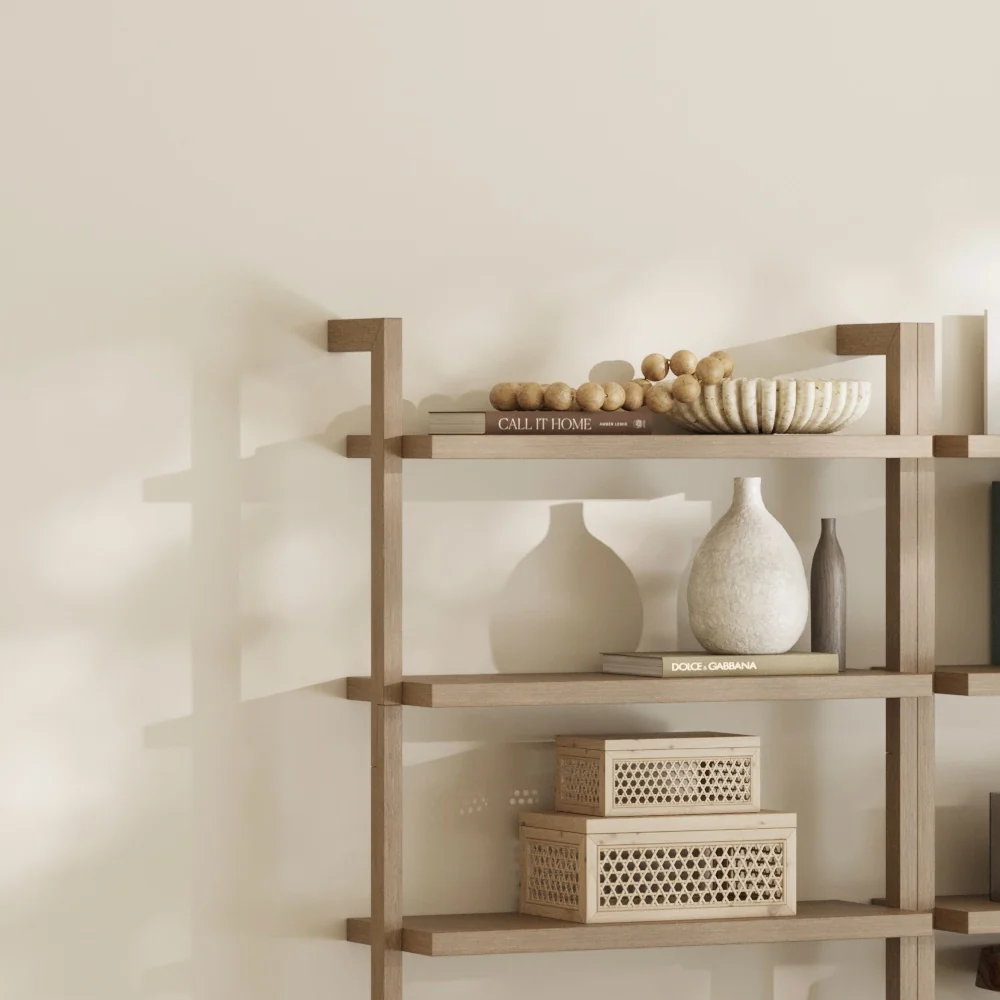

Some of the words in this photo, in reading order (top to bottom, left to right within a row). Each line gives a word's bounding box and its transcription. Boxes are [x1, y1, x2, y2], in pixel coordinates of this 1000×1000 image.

[498, 417, 533, 431] CALL
[535, 417, 548, 430] IT
[551, 417, 592, 431] HOME
[671, 662, 703, 672] DOLCE
[708, 661, 757, 671] GABBANA
